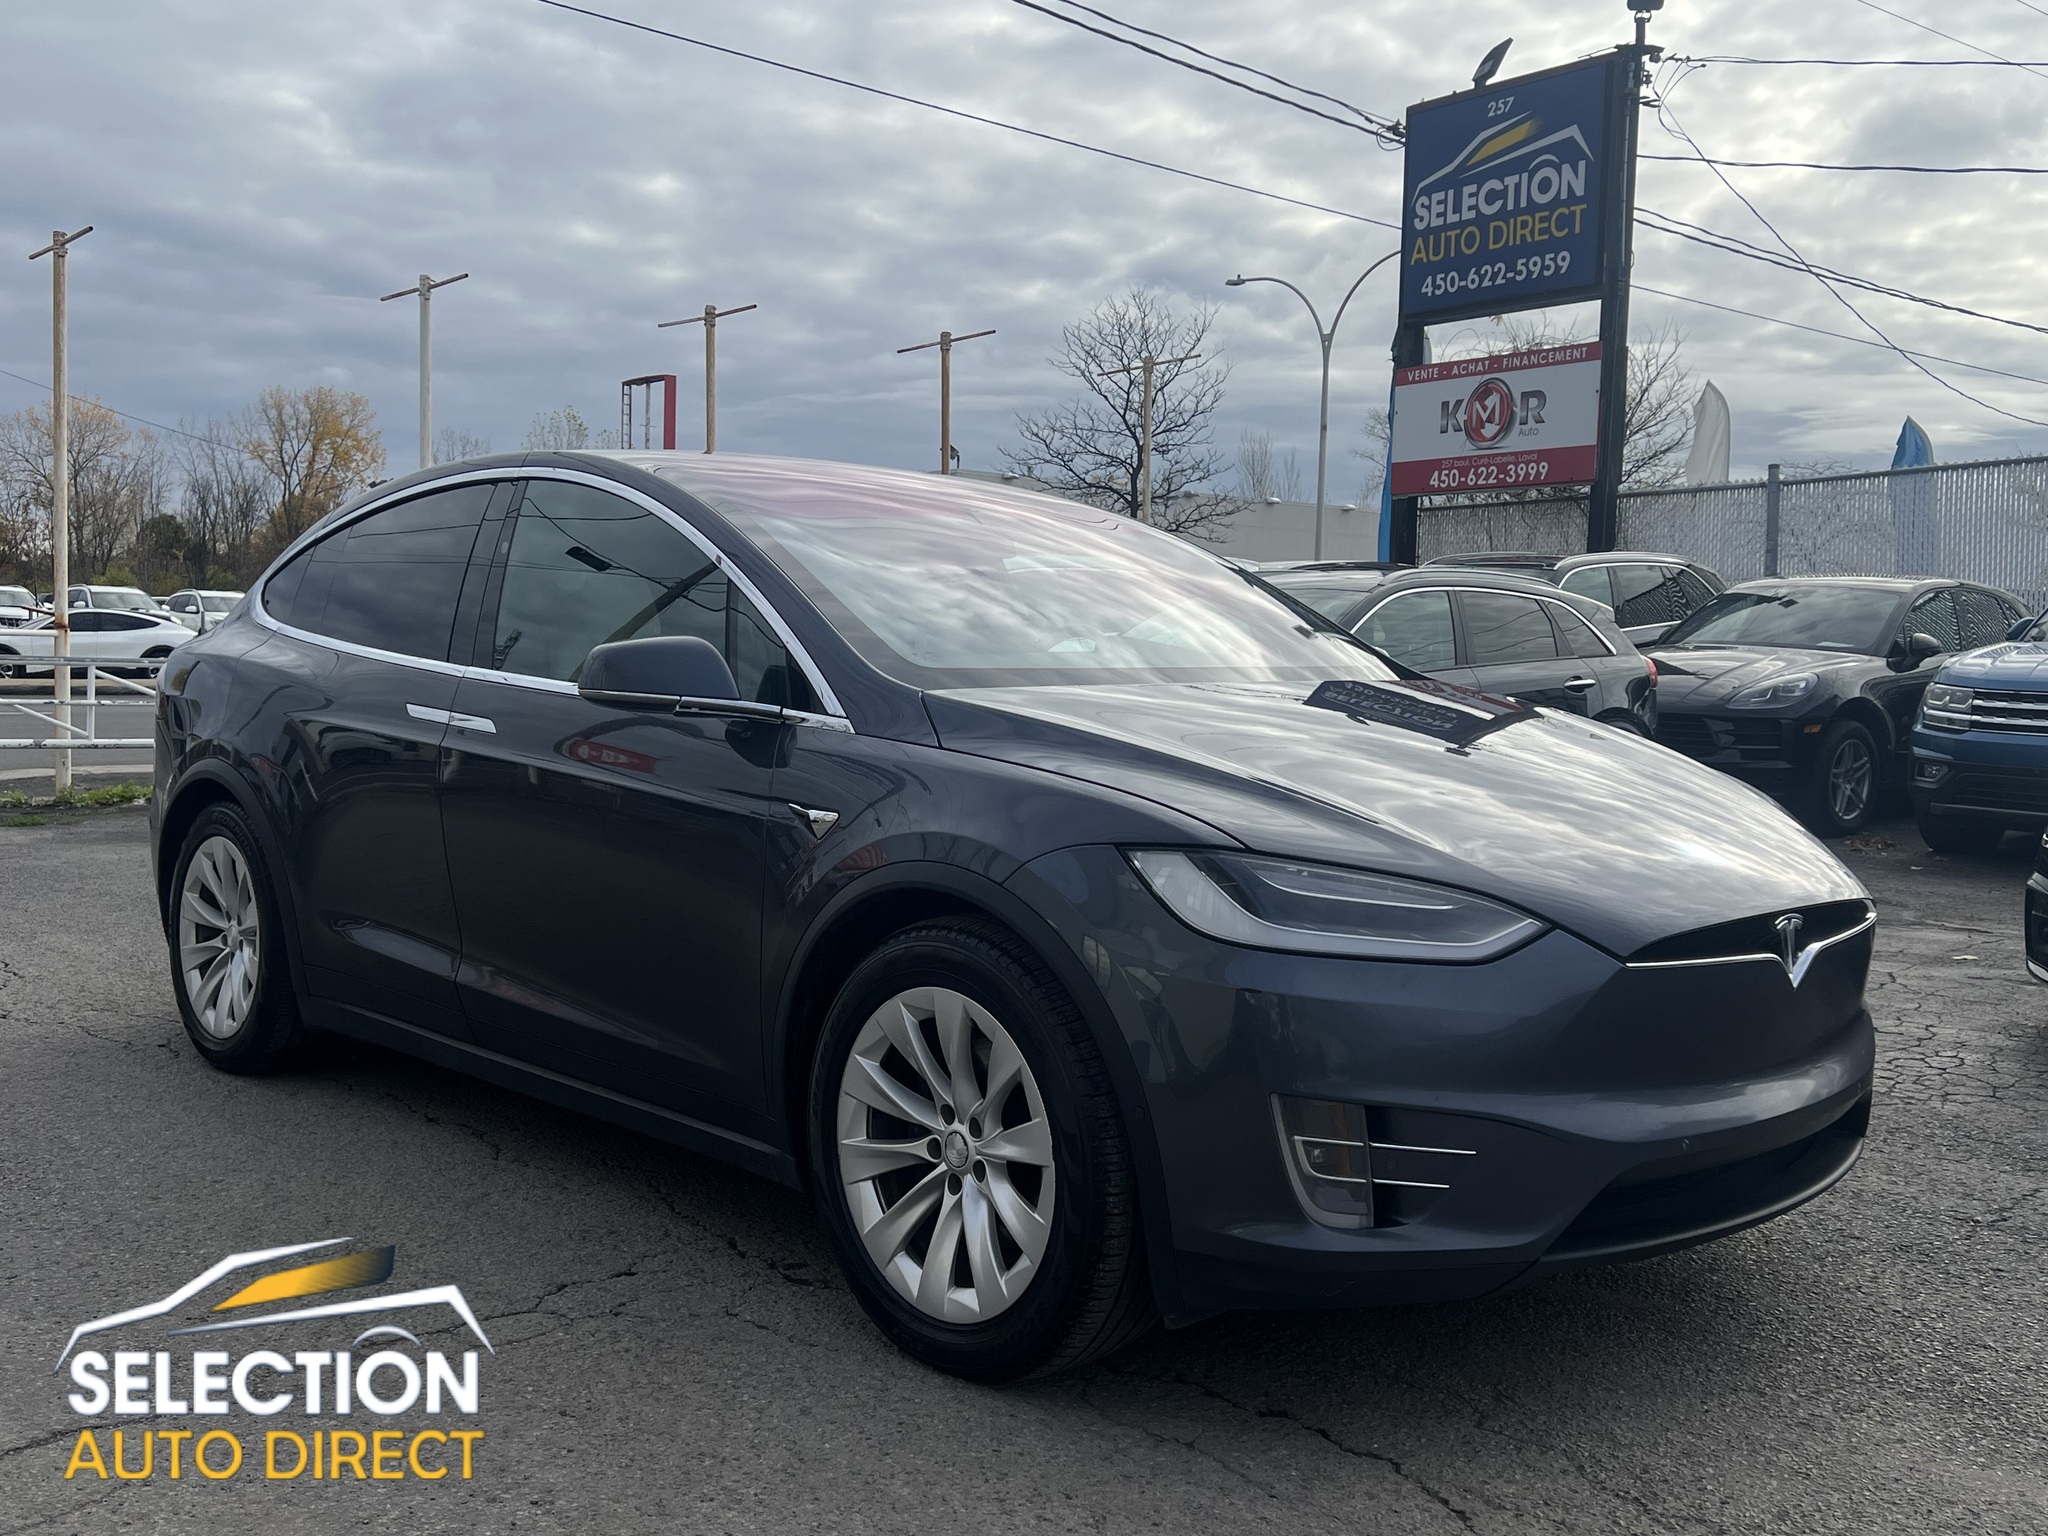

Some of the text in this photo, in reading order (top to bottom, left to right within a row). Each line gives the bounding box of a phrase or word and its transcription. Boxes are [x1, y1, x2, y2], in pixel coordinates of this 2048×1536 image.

[1487, 96, 1515, 117] 257
[1413, 160, 1586, 231] SELECTION
[1410, 204, 1587, 266] AUTO DIRECT
[1421, 250, 1571, 297] 450-622-5959
[1407, 367, 1439, 382] VENTE
[1451, 360, 1490, 376] ACHAT
[1502, 347, 1588, 369] FINANCEMENT
[1518, 427, 1539, 437] Auto
[1519, 453, 1537, 462] Laval
[1430, 461, 1549, 489] 450-622-3999
